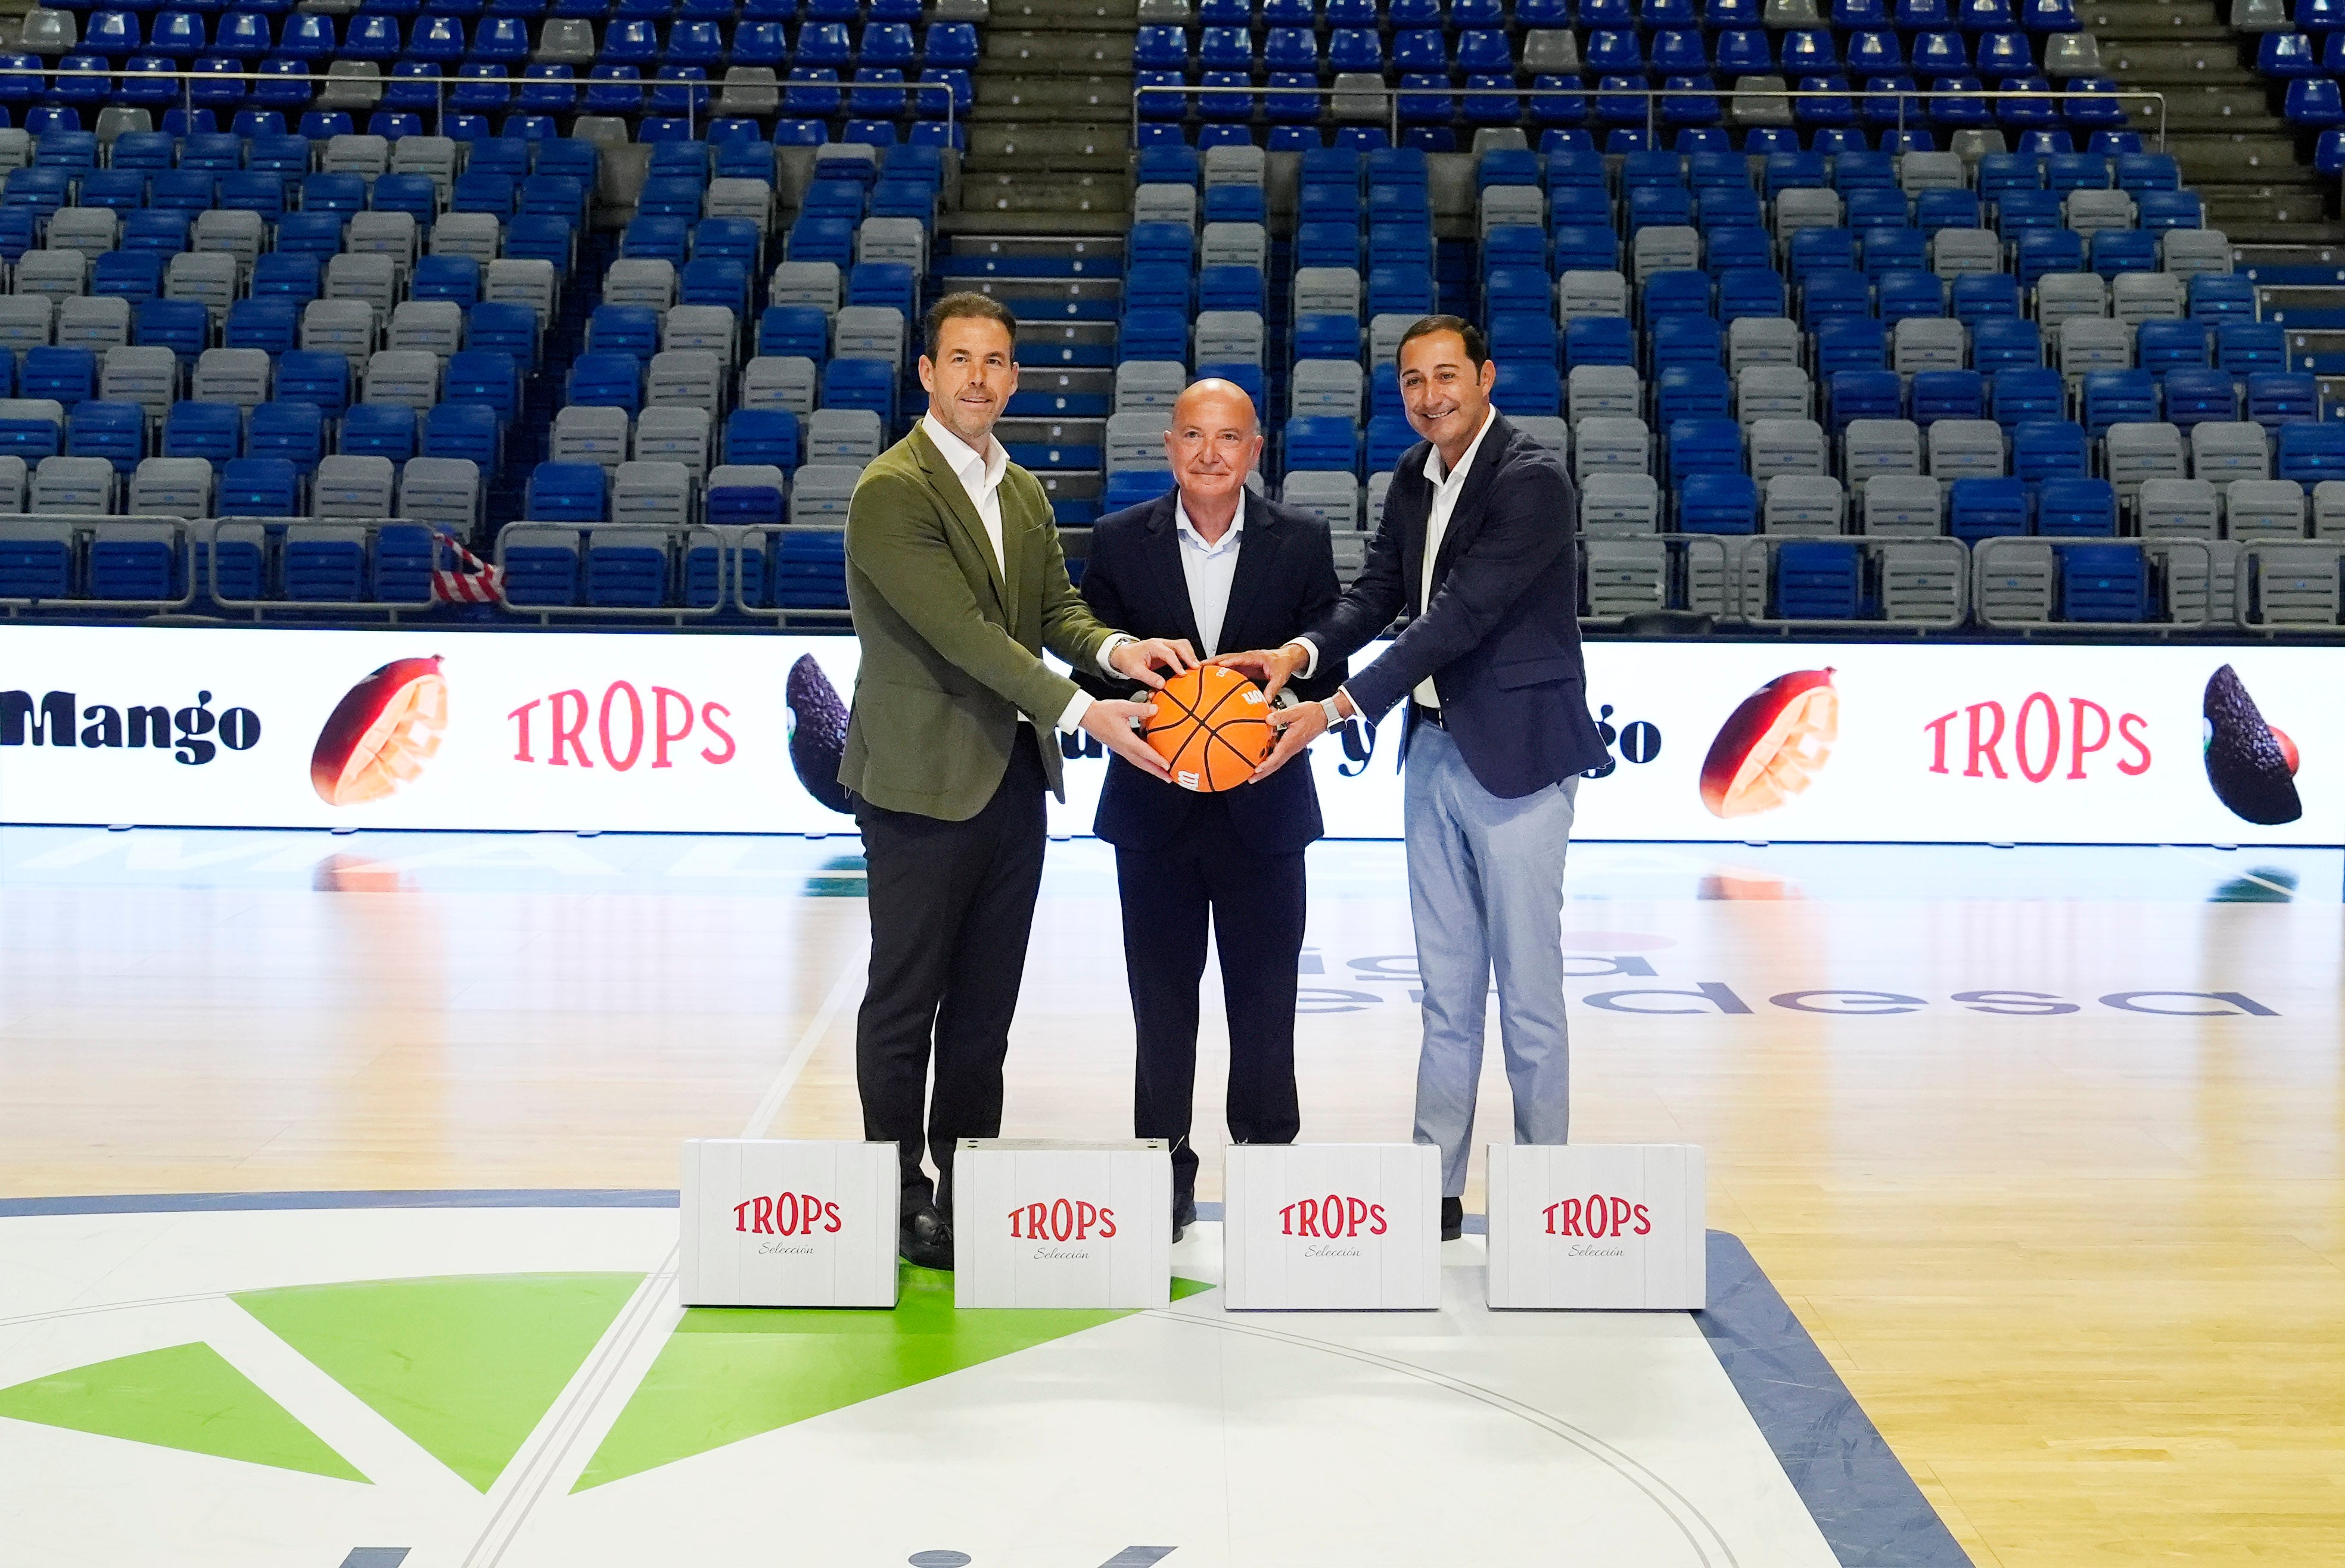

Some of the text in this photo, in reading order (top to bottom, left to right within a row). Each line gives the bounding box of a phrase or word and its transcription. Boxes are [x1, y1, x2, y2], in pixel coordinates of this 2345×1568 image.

[0, 690, 261, 765] Mango
[508, 680, 736, 772] TROPS
[1924, 691, 2152, 783] TROPS
[1295, 982, 2282, 1016] edesa
[733, 1191, 842, 1237] TROPS
[1008, 1198, 1116, 1242] TROPS
[1279, 1194, 1388, 1239] TROPS
[1542, 1194, 1652, 1239] TROPS
[758, 1242, 815, 1254] Selección
[1034, 1247, 1090, 1259] Selección
[1305, 1245, 1361, 1258] Selección
[1568, 1244, 1624, 1257] Selección
